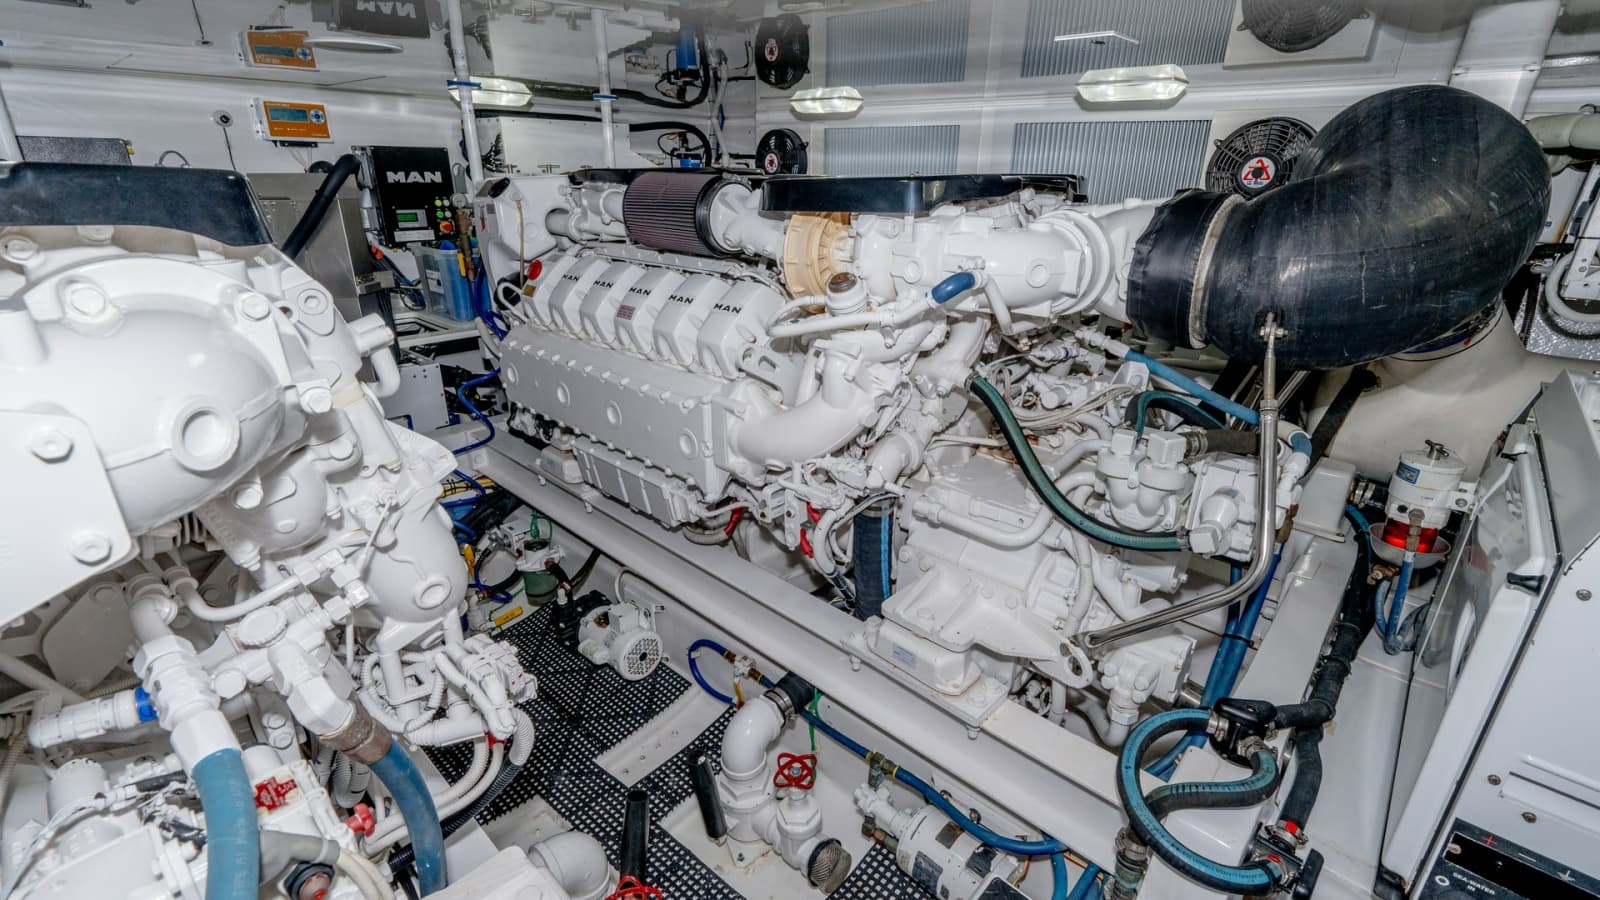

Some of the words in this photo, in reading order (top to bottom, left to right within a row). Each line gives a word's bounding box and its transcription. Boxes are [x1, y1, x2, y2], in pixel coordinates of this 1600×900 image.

[386, 171, 442, 183] MAN
[561, 274, 580, 282] MAN
[628, 287, 652, 296] MAN
[668, 294, 694, 304] MAN
[713, 303, 742, 314] MAN
